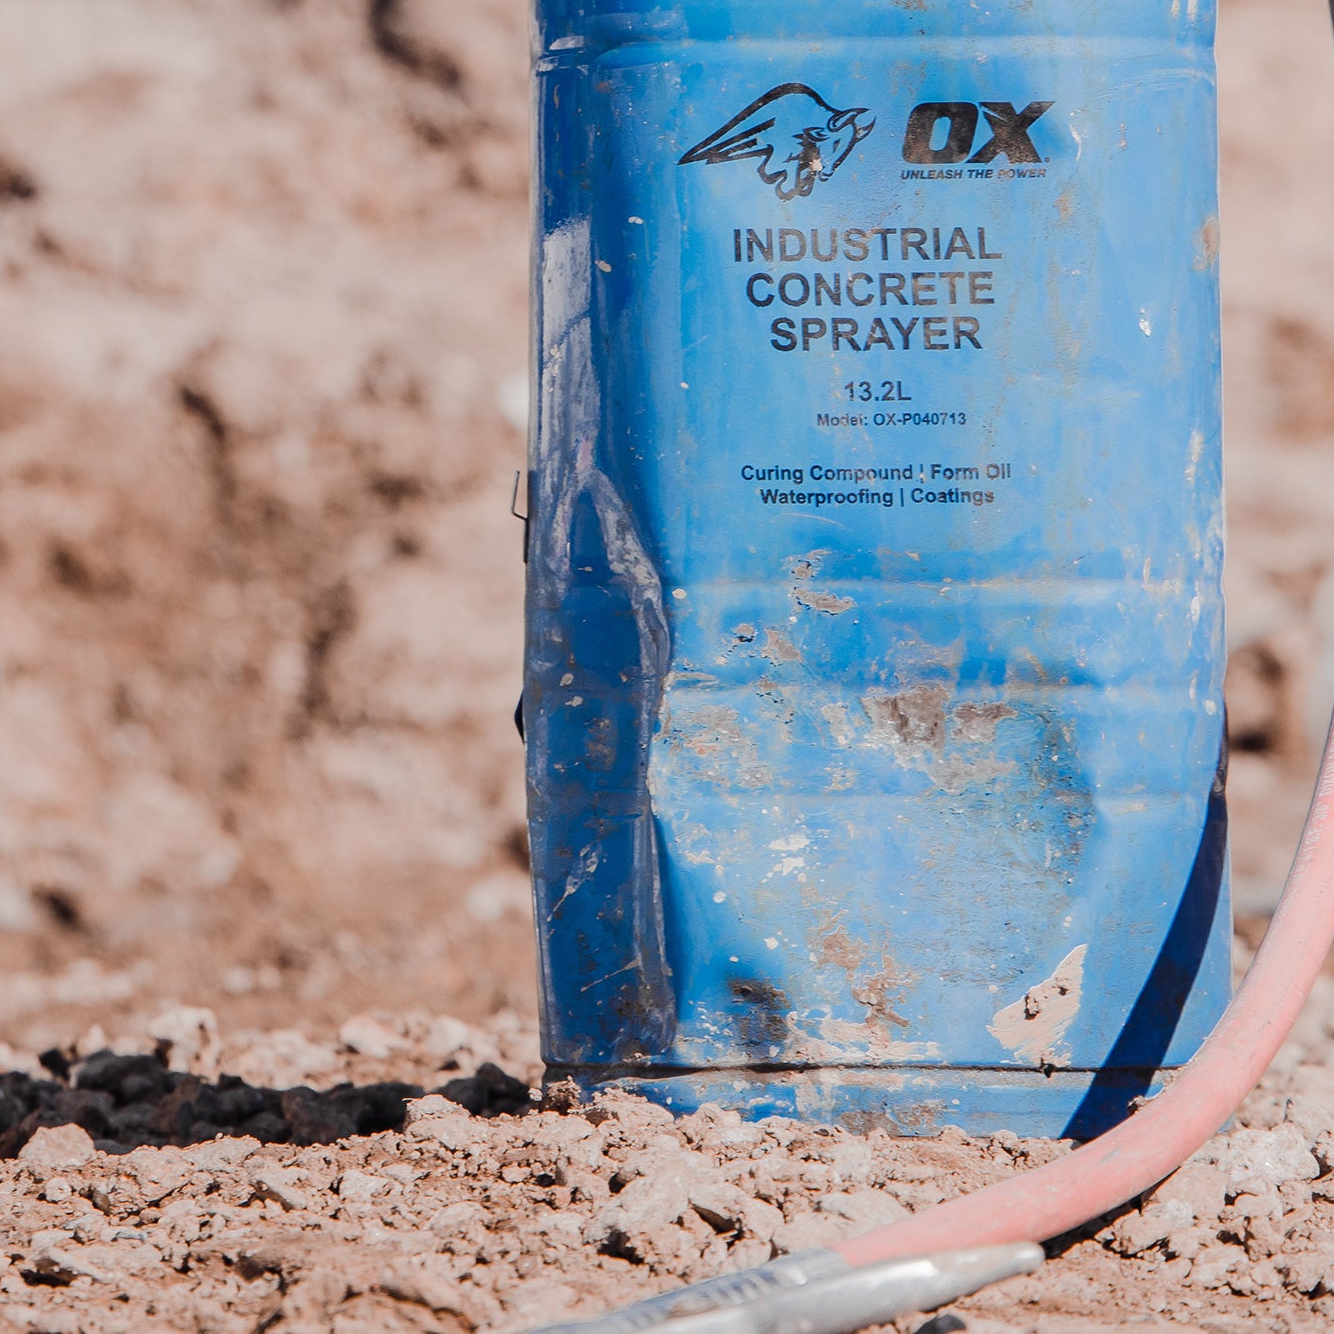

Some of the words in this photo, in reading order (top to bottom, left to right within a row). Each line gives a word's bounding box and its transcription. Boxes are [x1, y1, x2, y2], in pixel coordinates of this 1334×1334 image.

[902, 101, 1055, 164] OX
[900, 169, 963, 180] UNLEASH
[967, 169, 994, 179] THE
[997, 168, 1047, 180] POWER
[733, 227, 1003, 263] INDUSTRIAL
[746, 271, 996, 307] CONCRETE
[771, 316, 983, 352] SPRAYER
[844, 380, 912, 402] 13.2L
[817, 413, 869, 426] Model:
[873, 412, 967, 426] OX-P040713
[741, 464, 804, 485] Curing
[810, 464, 913, 484] Compound
[930, 463, 979, 481] Form
[986, 462, 1011, 481] Oil
[760, 488, 893, 508] Waterproofing
[911, 487, 995, 507] Coatings
